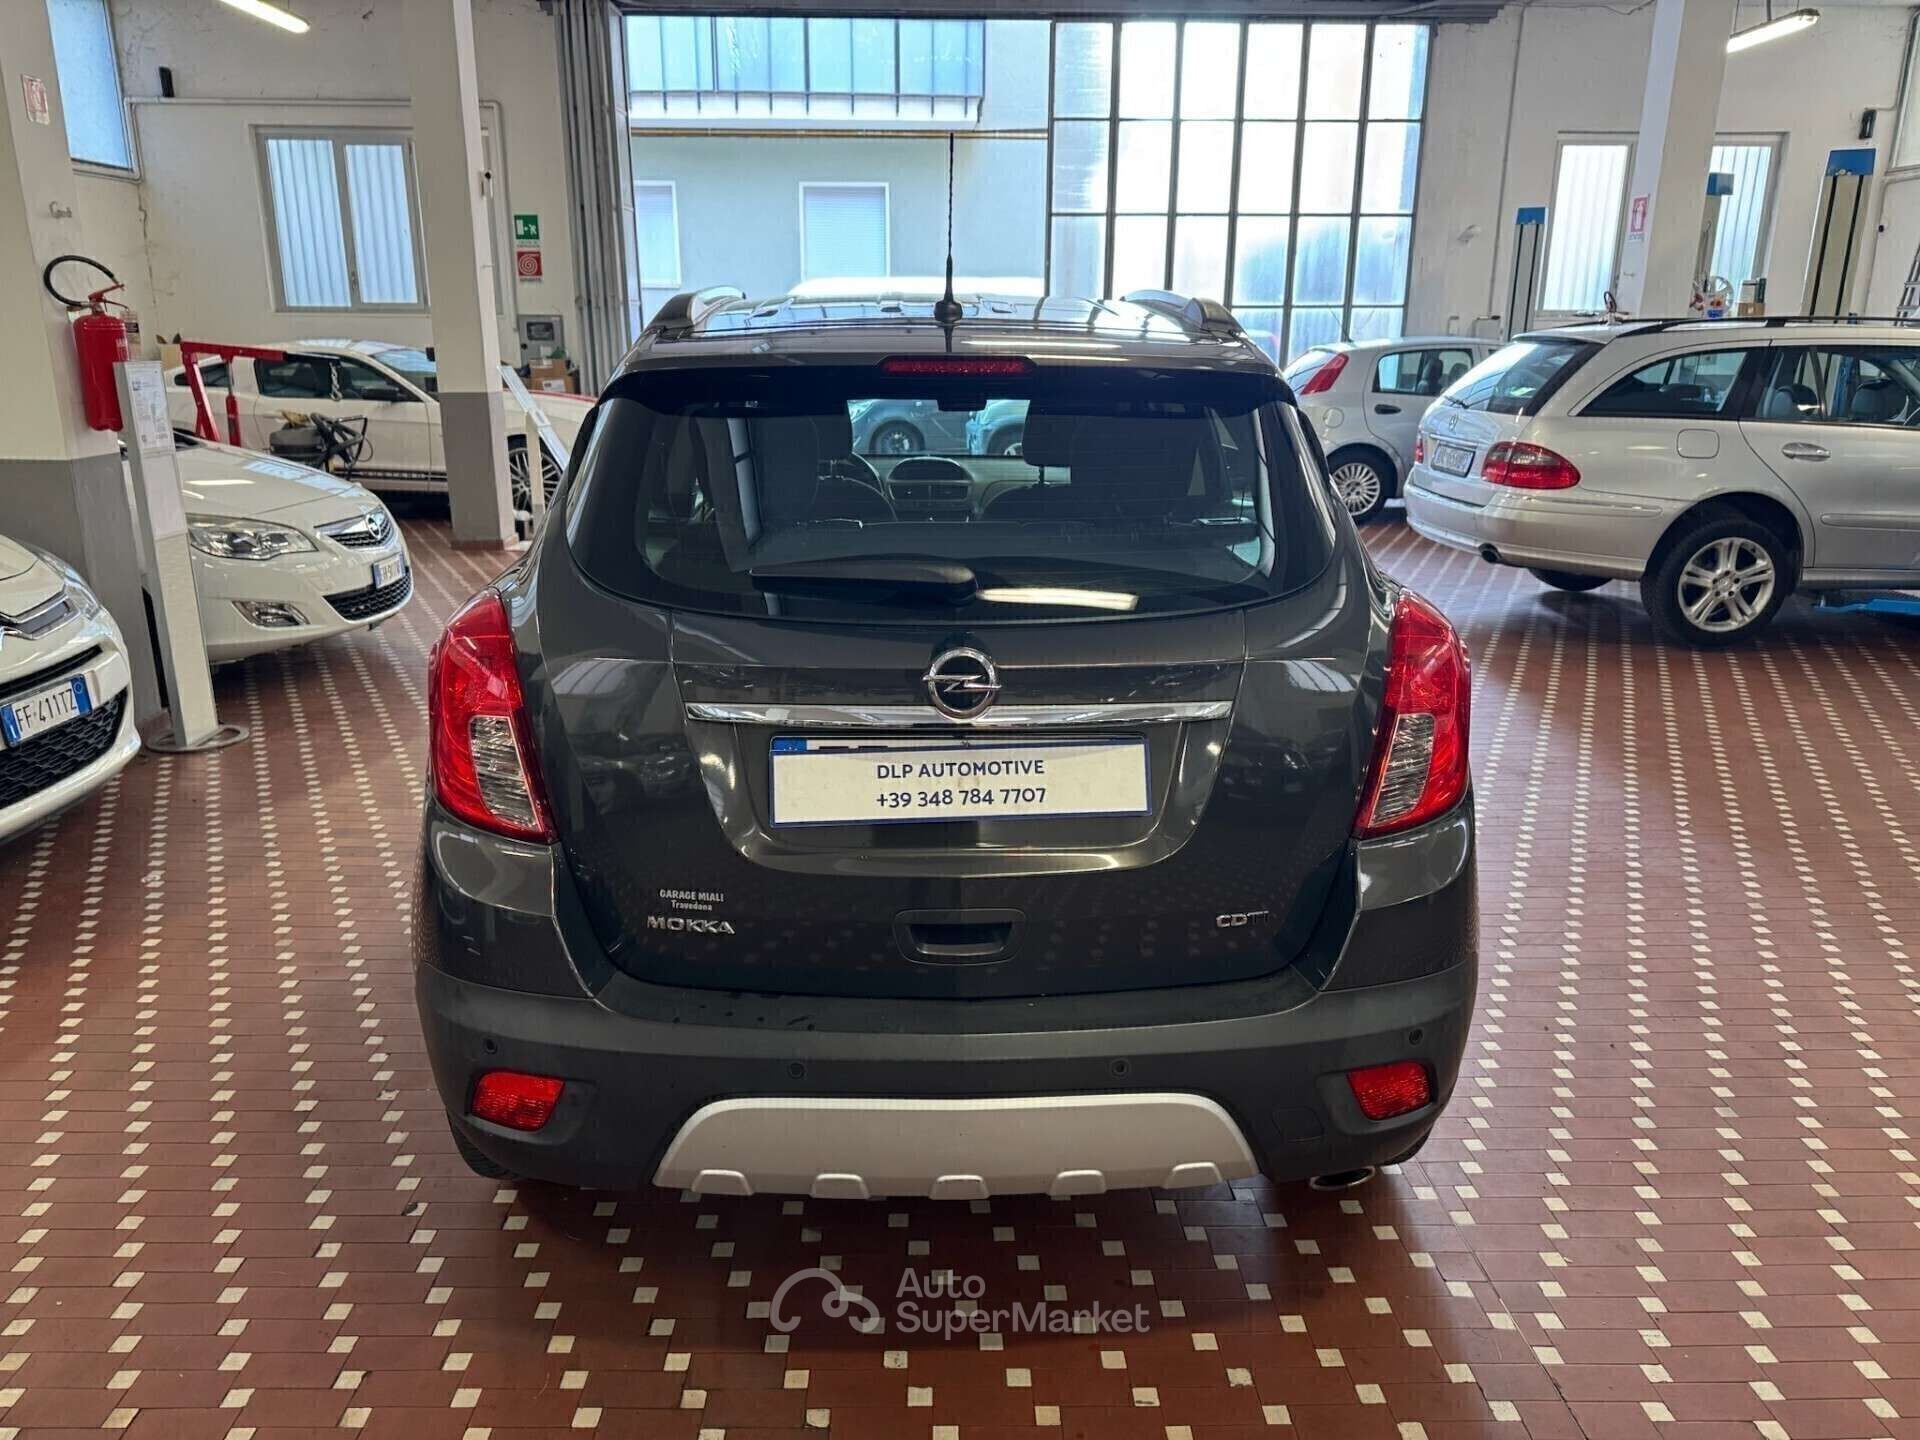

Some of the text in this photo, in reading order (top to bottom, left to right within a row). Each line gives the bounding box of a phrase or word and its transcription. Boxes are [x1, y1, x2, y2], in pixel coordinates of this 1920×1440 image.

[877, 760, 1045, 779] DLP AUTOMOTIVE
[876, 787, 1046, 808] +39 348 784 7707
[659, 888, 724, 902] GARAGE MIALI
[671, 899, 713, 911] Travedona
[647, 915, 735, 935] MOKKA
